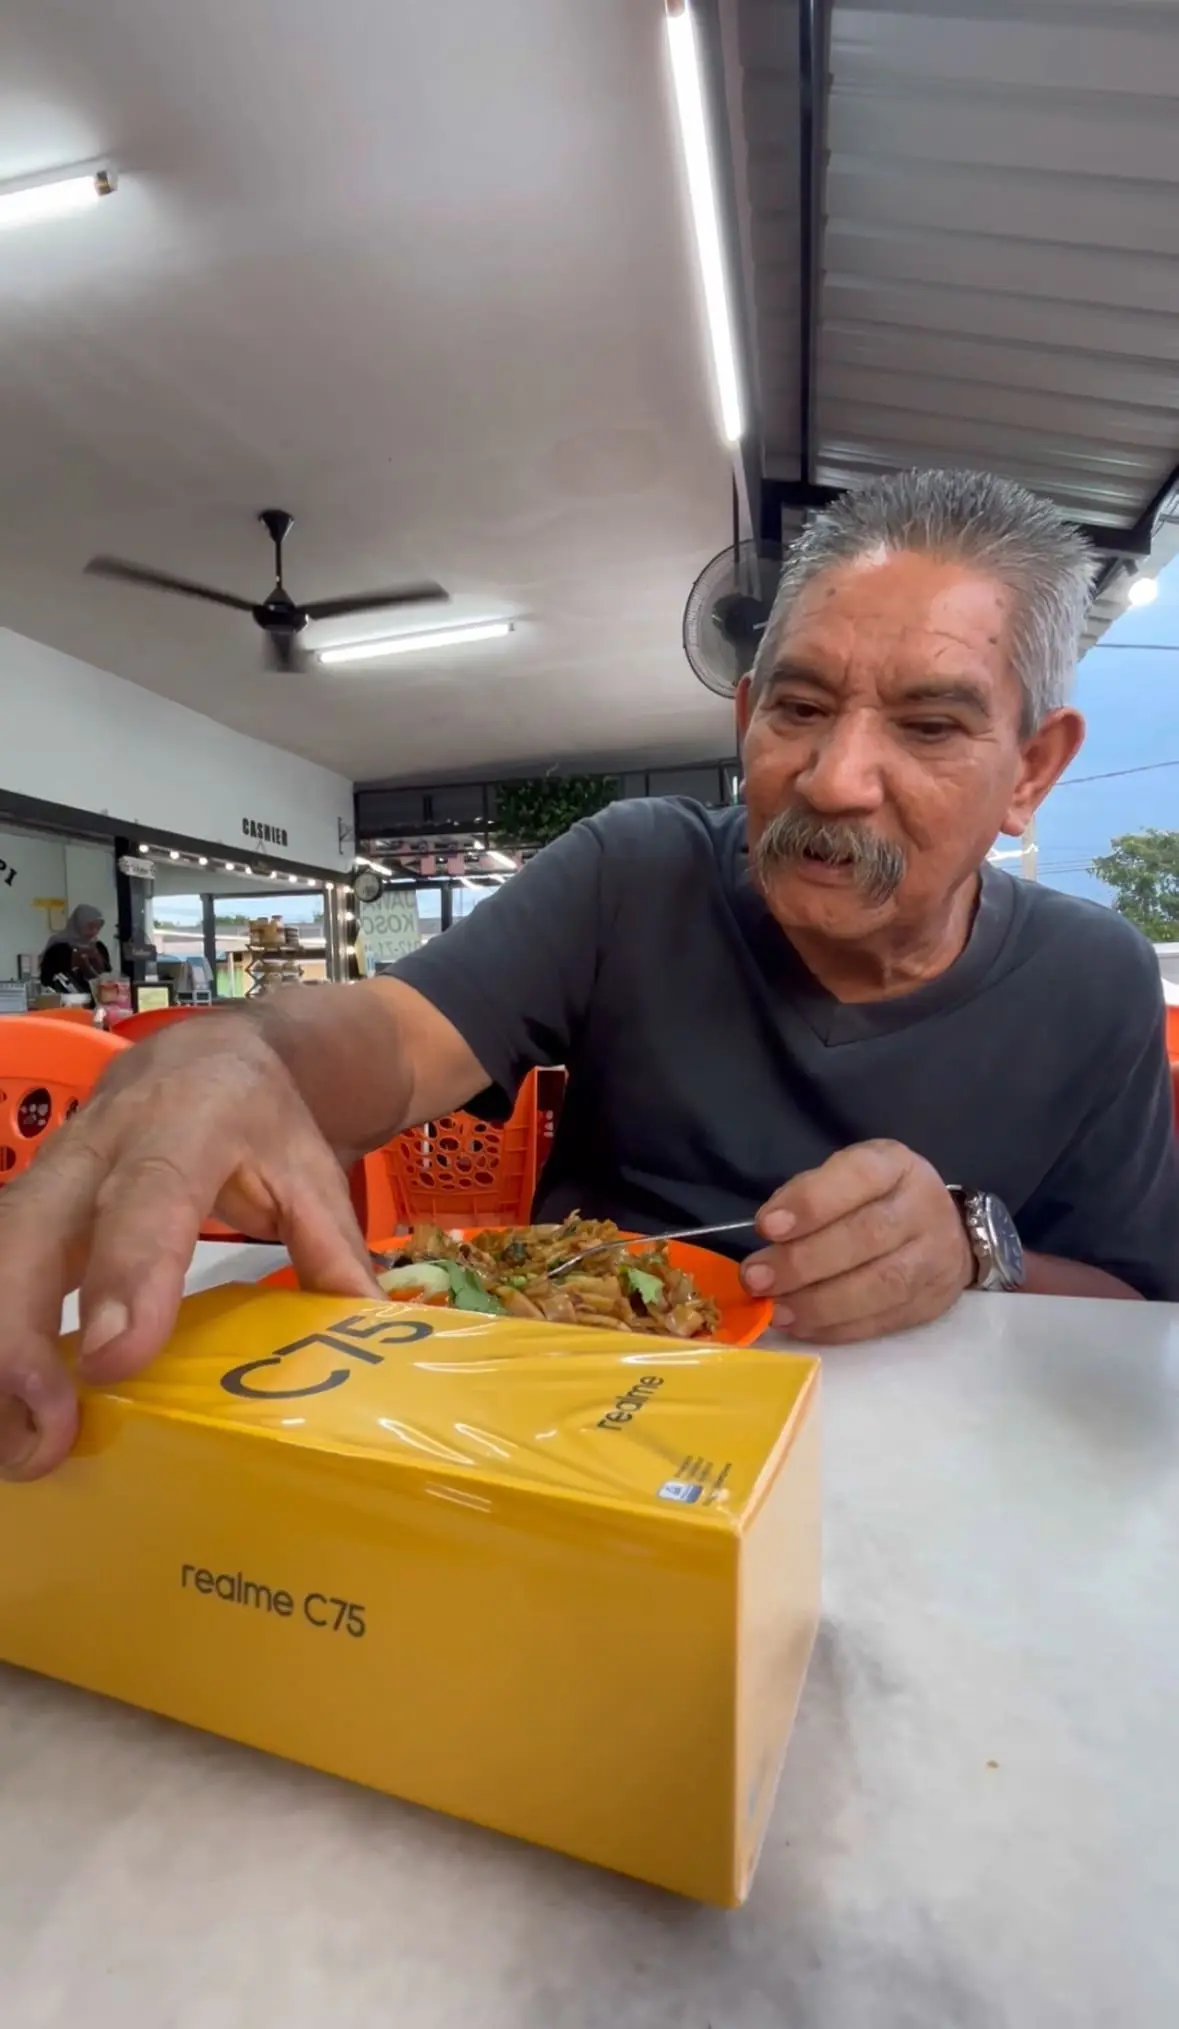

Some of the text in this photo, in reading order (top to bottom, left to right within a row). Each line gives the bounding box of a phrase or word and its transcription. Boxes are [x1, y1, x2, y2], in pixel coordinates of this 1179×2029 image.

[243, 818, 288, 847] CASHIER
[220, 1315, 433, 1400] C75
[597, 1375, 665, 1431] realme
[181, 1563, 366, 1638] realme C75
